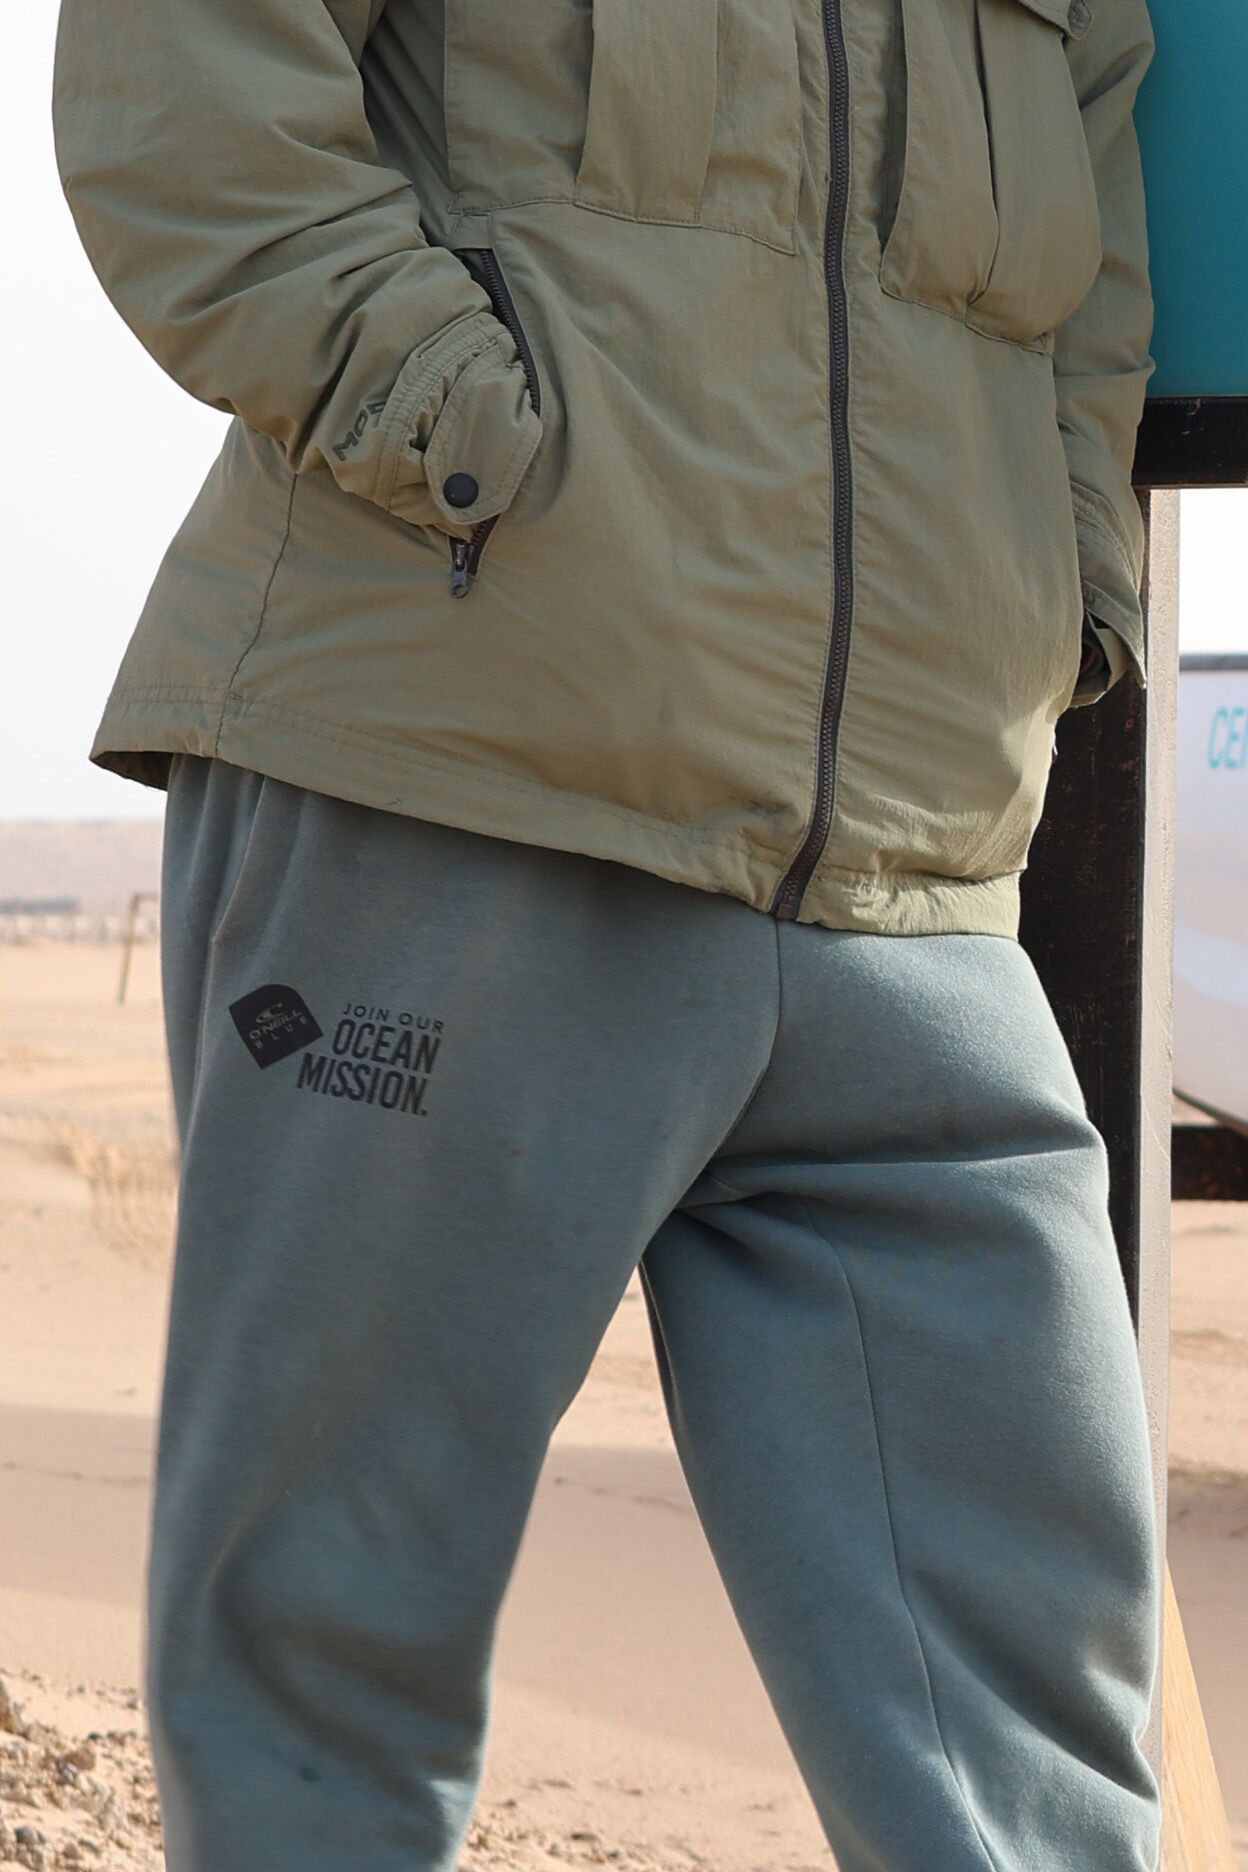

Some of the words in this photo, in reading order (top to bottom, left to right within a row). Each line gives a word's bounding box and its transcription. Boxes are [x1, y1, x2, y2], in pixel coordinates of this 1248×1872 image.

[343, 1003, 389, 1022] JOIN
[398, 1012, 445, 1034] OUR
[331, 1019, 441, 1074] OCEAN
[296, 1052, 428, 1116] MISSION.
